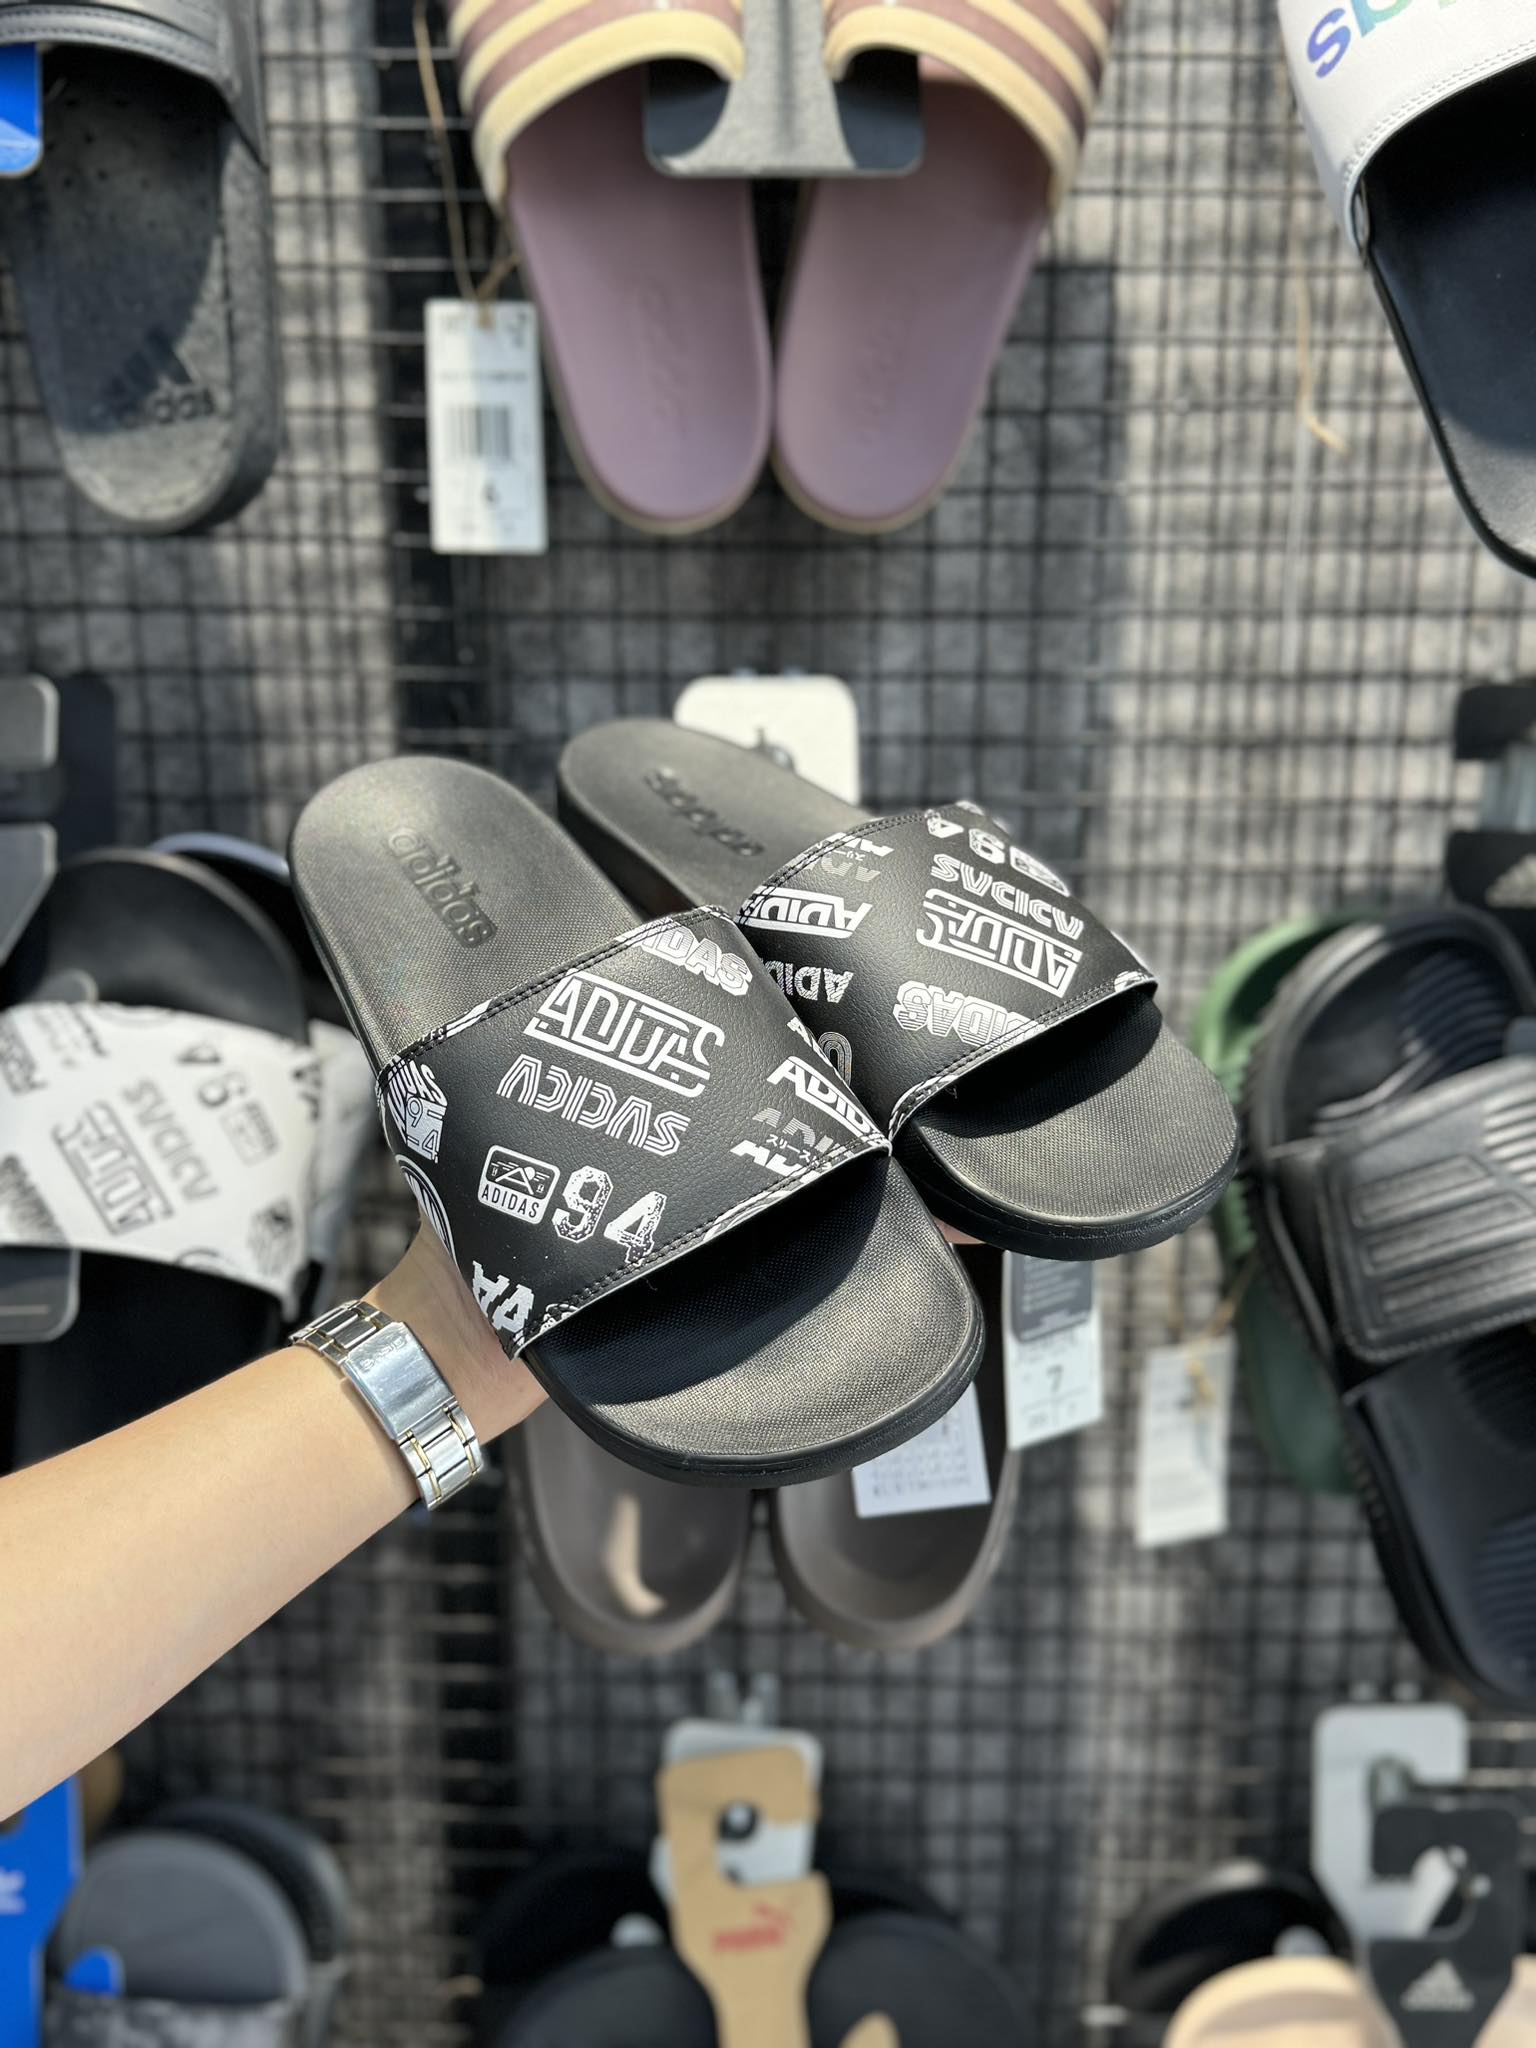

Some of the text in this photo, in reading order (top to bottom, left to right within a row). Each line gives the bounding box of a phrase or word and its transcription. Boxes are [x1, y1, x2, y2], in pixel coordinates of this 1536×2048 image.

[388, 828, 498, 948] adidas
[496, 1054, 691, 1156] ADIDAS
[481, 1184, 540, 1218] ADIDAS
[551, 1165, 668, 1267] 94
